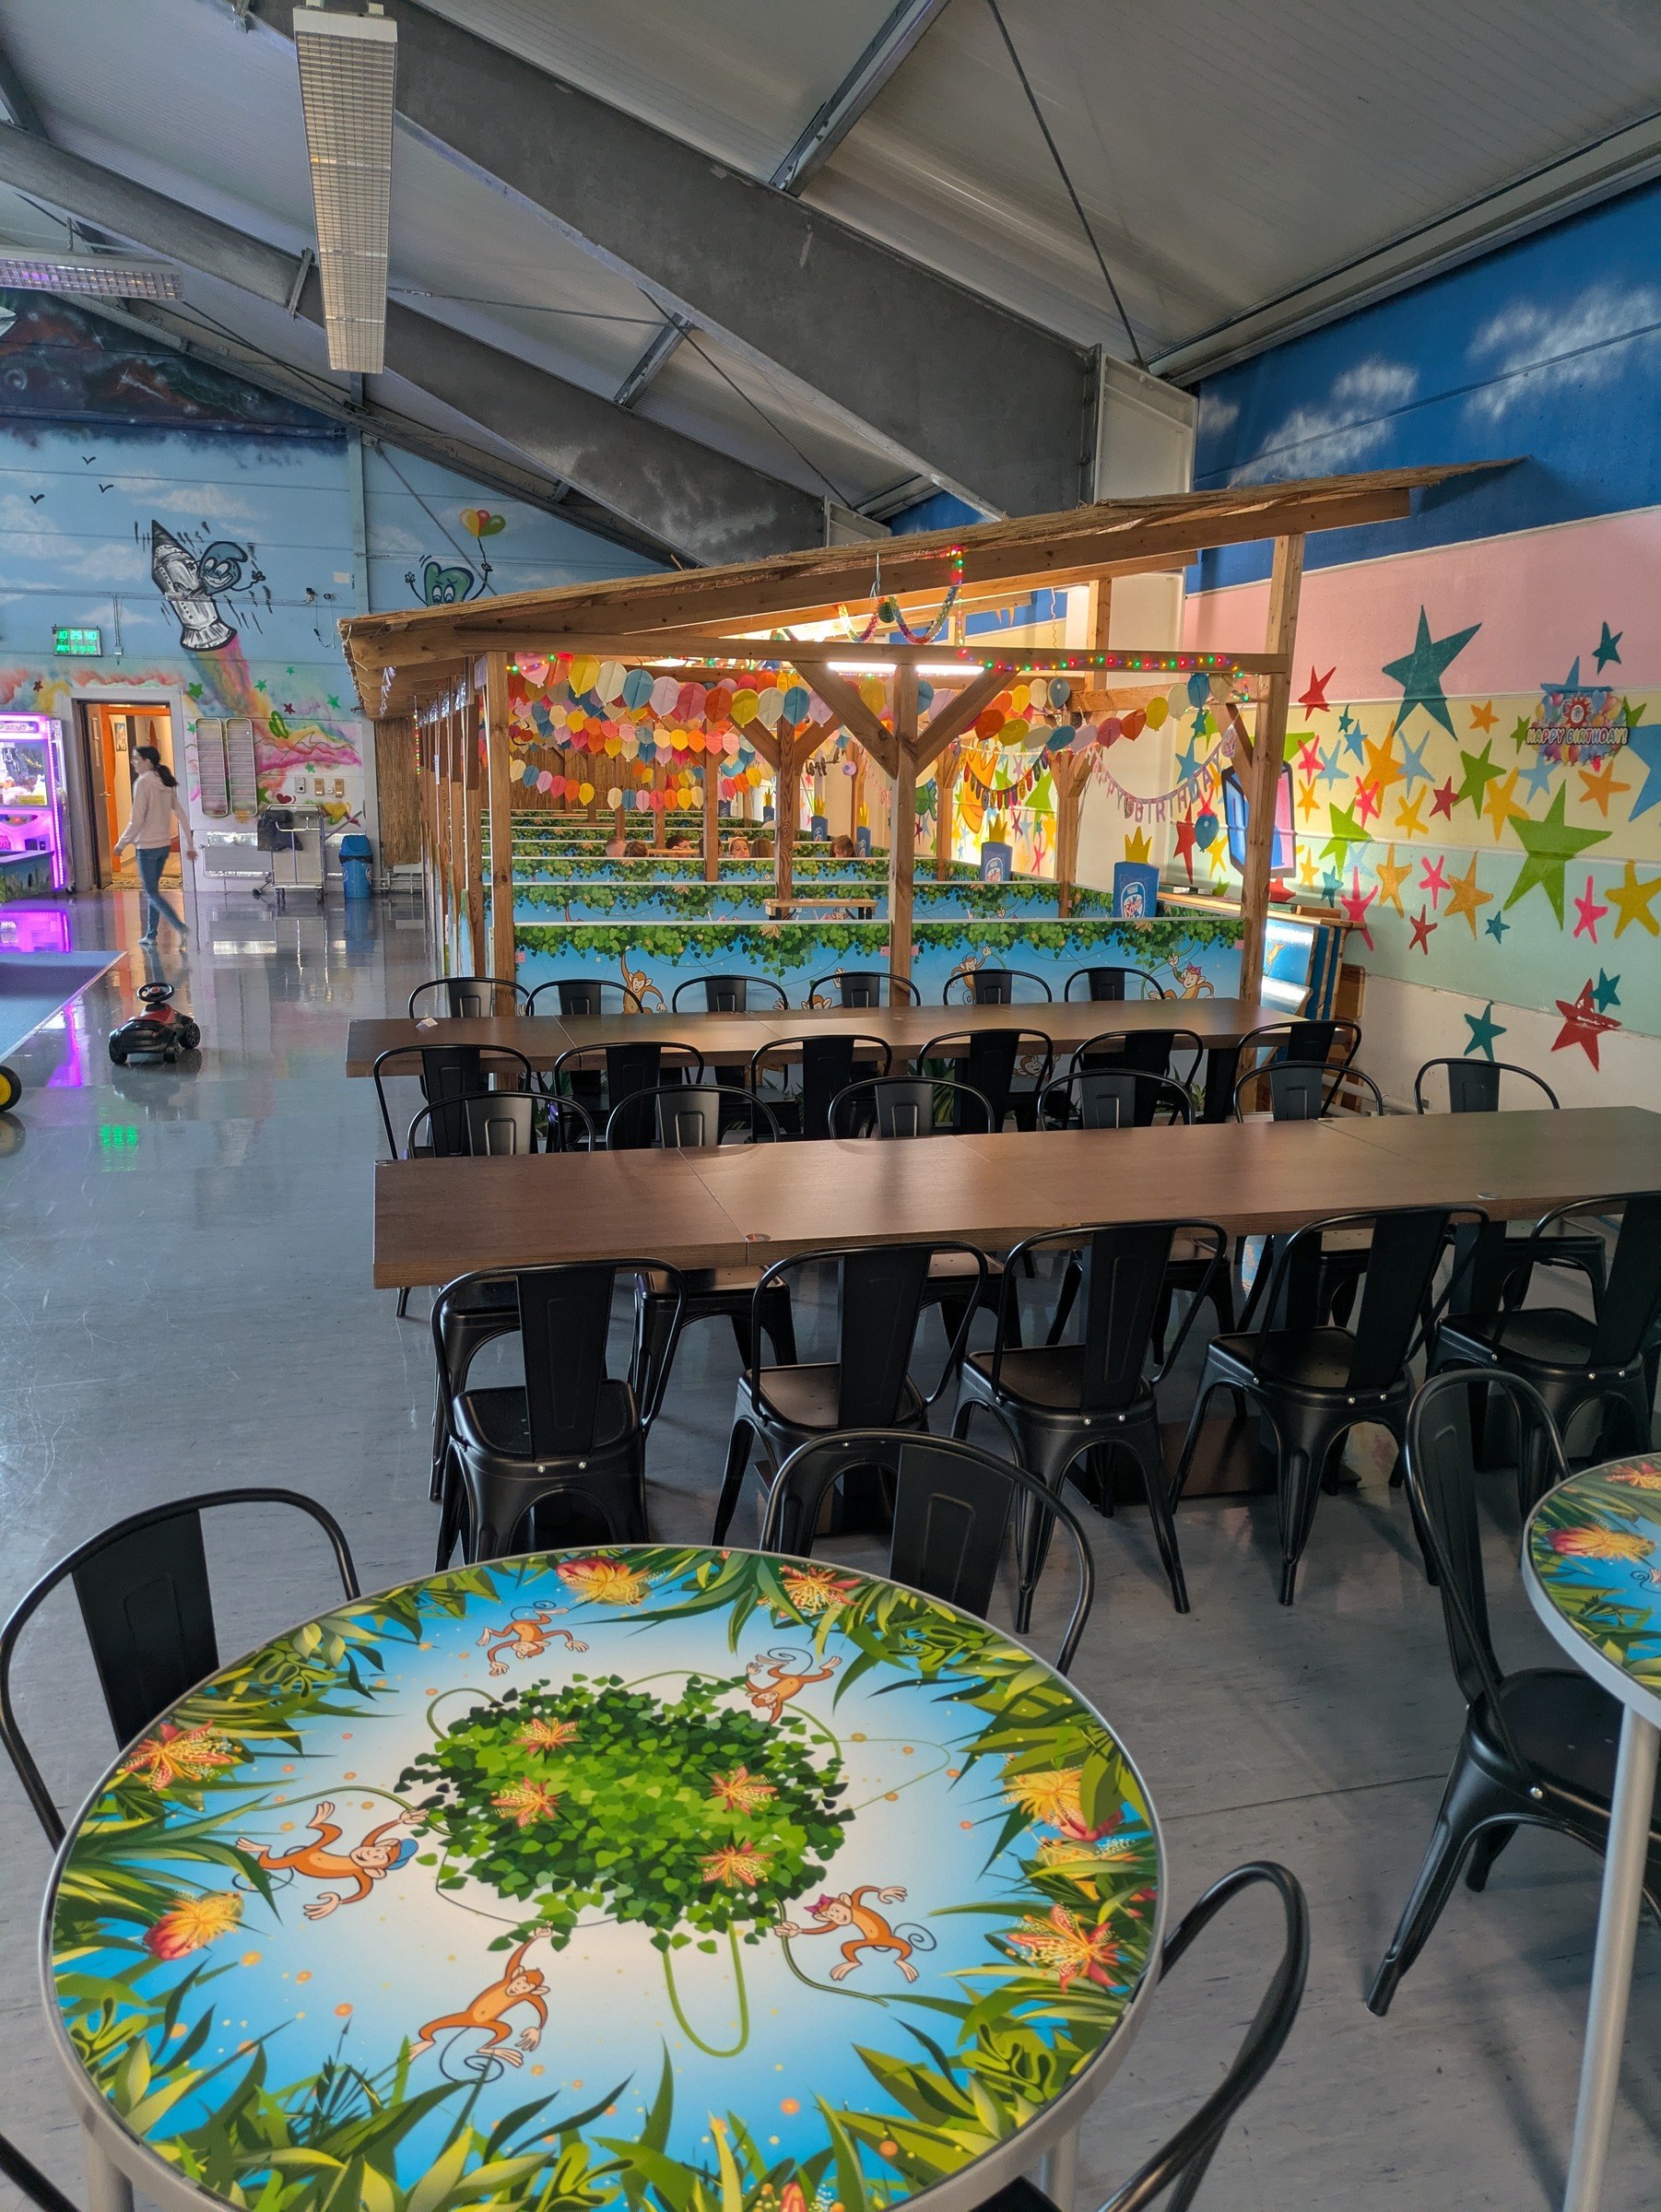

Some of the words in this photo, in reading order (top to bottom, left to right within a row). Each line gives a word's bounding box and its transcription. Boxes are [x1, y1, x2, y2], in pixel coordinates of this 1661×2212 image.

[59, 629, 68, 640] 10
[70, 629, 83, 641] 25
[85, 630, 98, 641] 40
[1526, 727, 1565, 745] HAPPY
